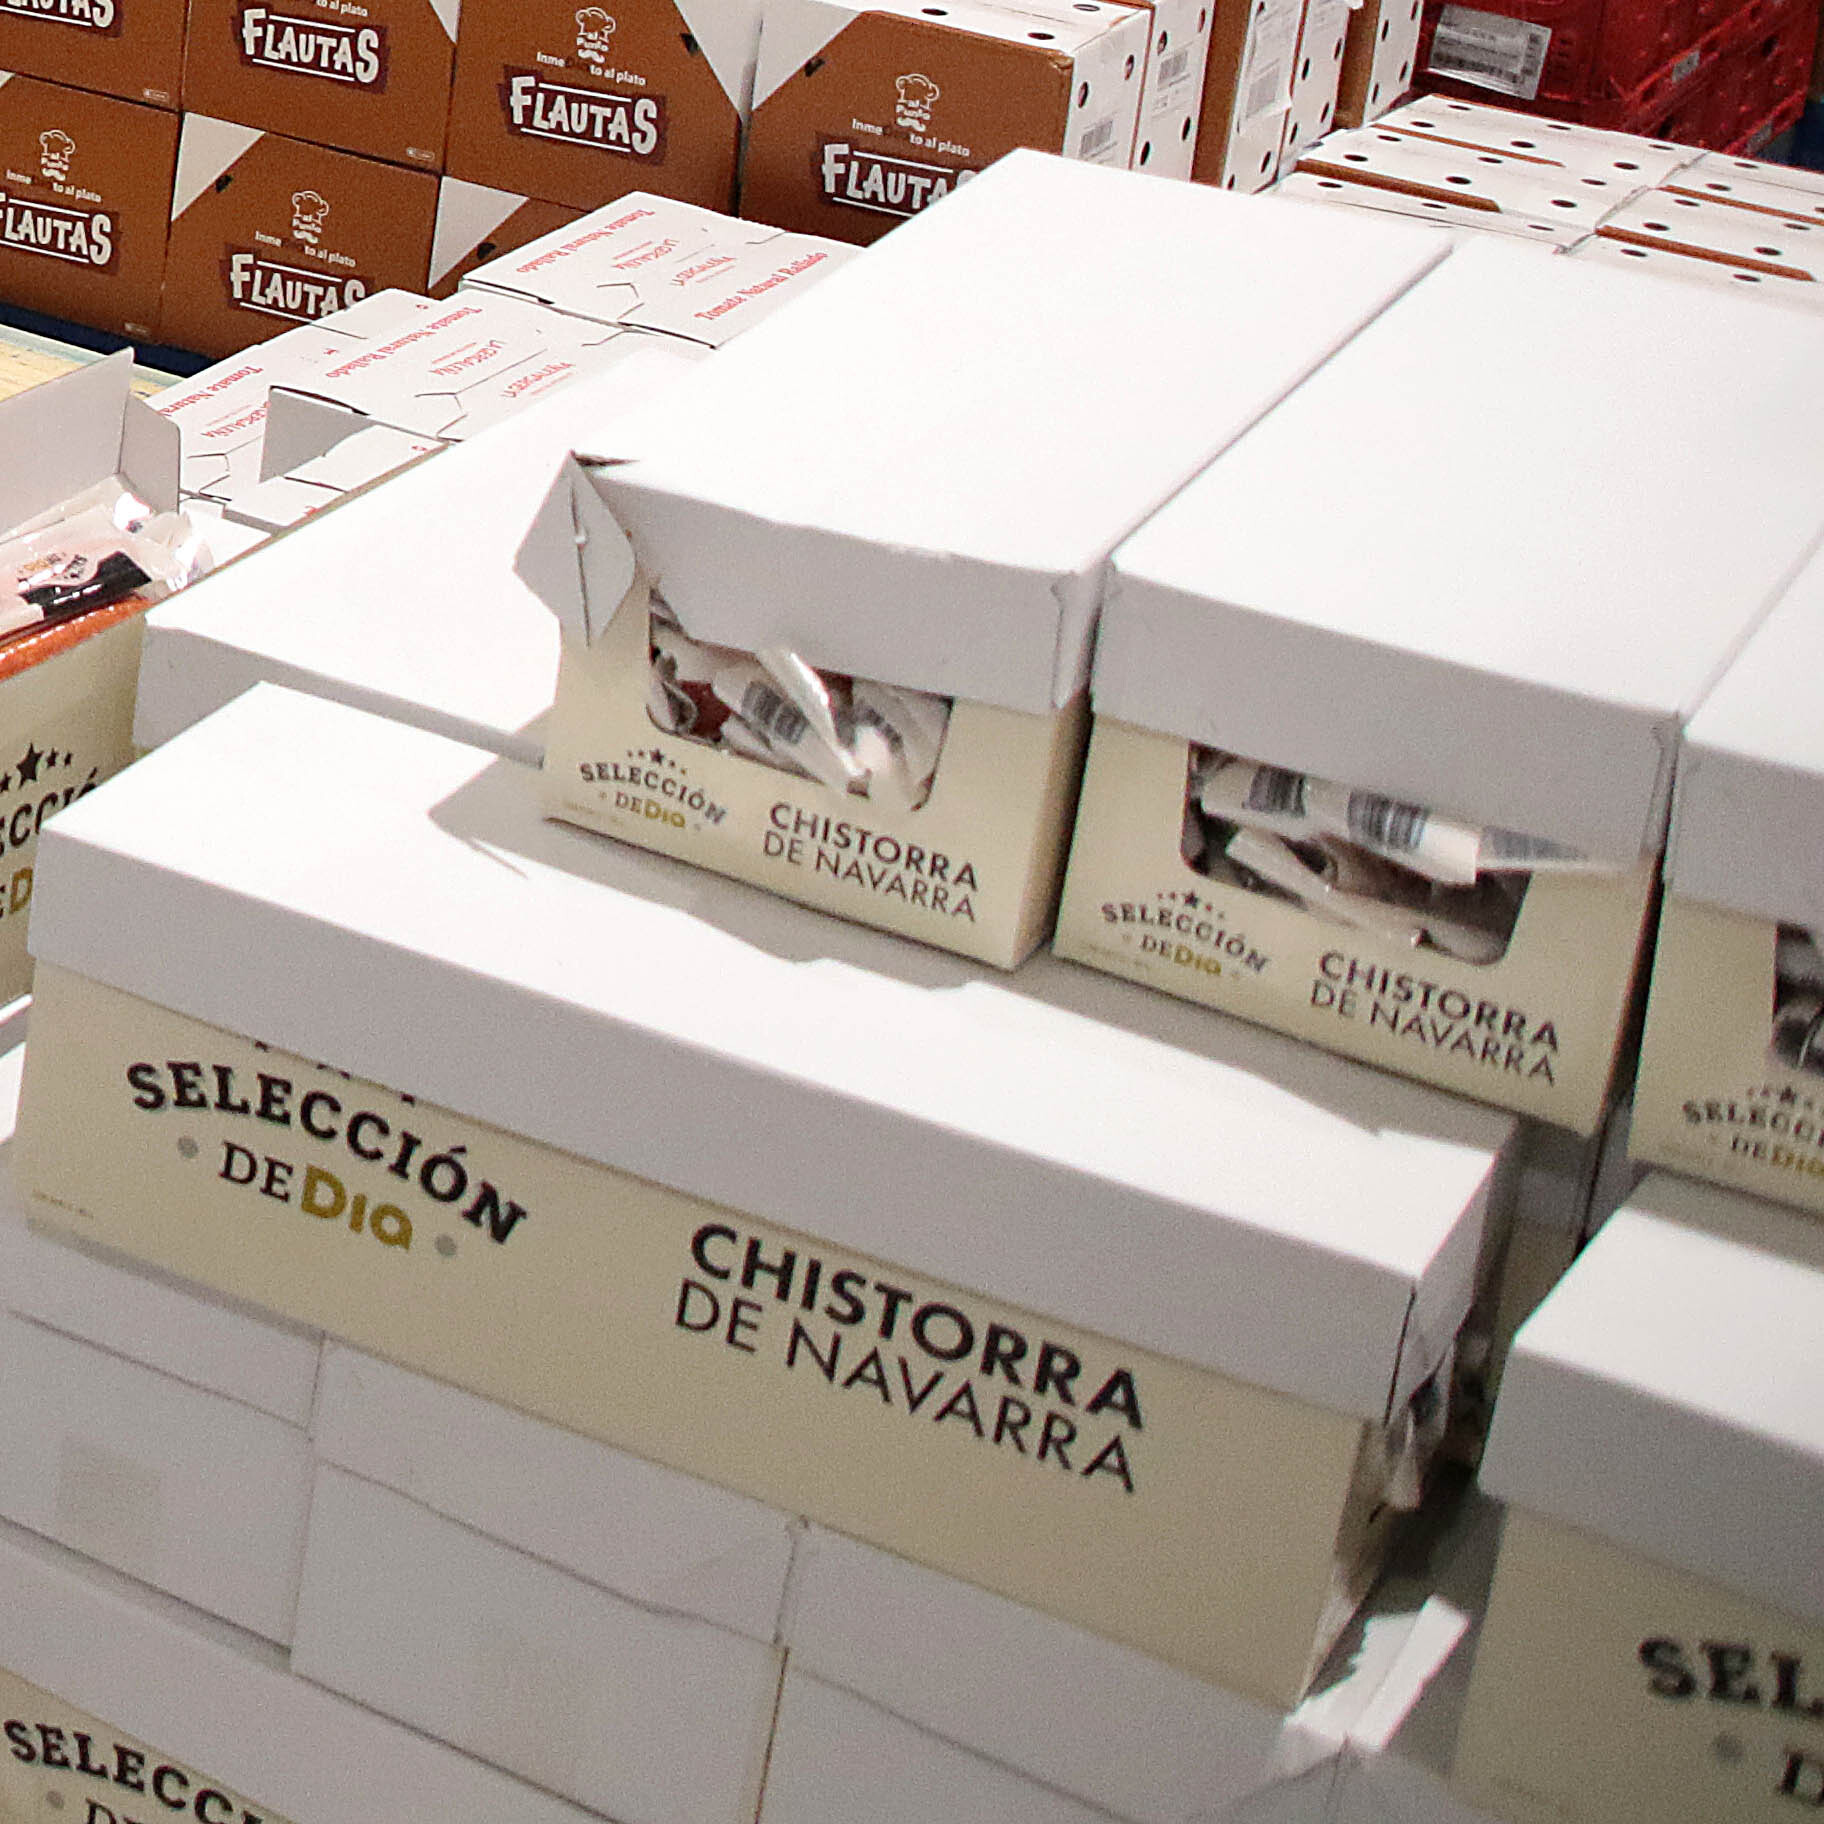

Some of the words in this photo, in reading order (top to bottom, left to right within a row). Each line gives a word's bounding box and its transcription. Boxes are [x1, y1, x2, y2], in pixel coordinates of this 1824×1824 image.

[242, 8, 380, 84] FLAUTAS
[510, 76, 658, 155] FLAUTAS
[379, 326, 441, 357] Natural
[425, 306, 483, 333] Tomate
[207, 364, 264, 393] Tomate
[325, 346, 385, 378] Rallado
[579, 760, 727, 825] SELECCIÓN
[762, 831, 803, 866] DE
[815, 848, 977, 923] NAVARRA
[769, 802, 978, 892] CHISTORRA
[1101, 902, 1267, 973] SELECCIÓN
[1311, 980, 1357, 1019] DE
[1370, 997, 1555, 1088] NAVARRA
[1320, 951, 1560, 1052] CHISTORRA
[126, 1058, 527, 1246] SELECCIÓN
[690, 1223, 1143, 1431] CHISTORRA
[675, 1278, 762, 1353] DE
[785, 1318, 1135, 1494] NAVARRA
